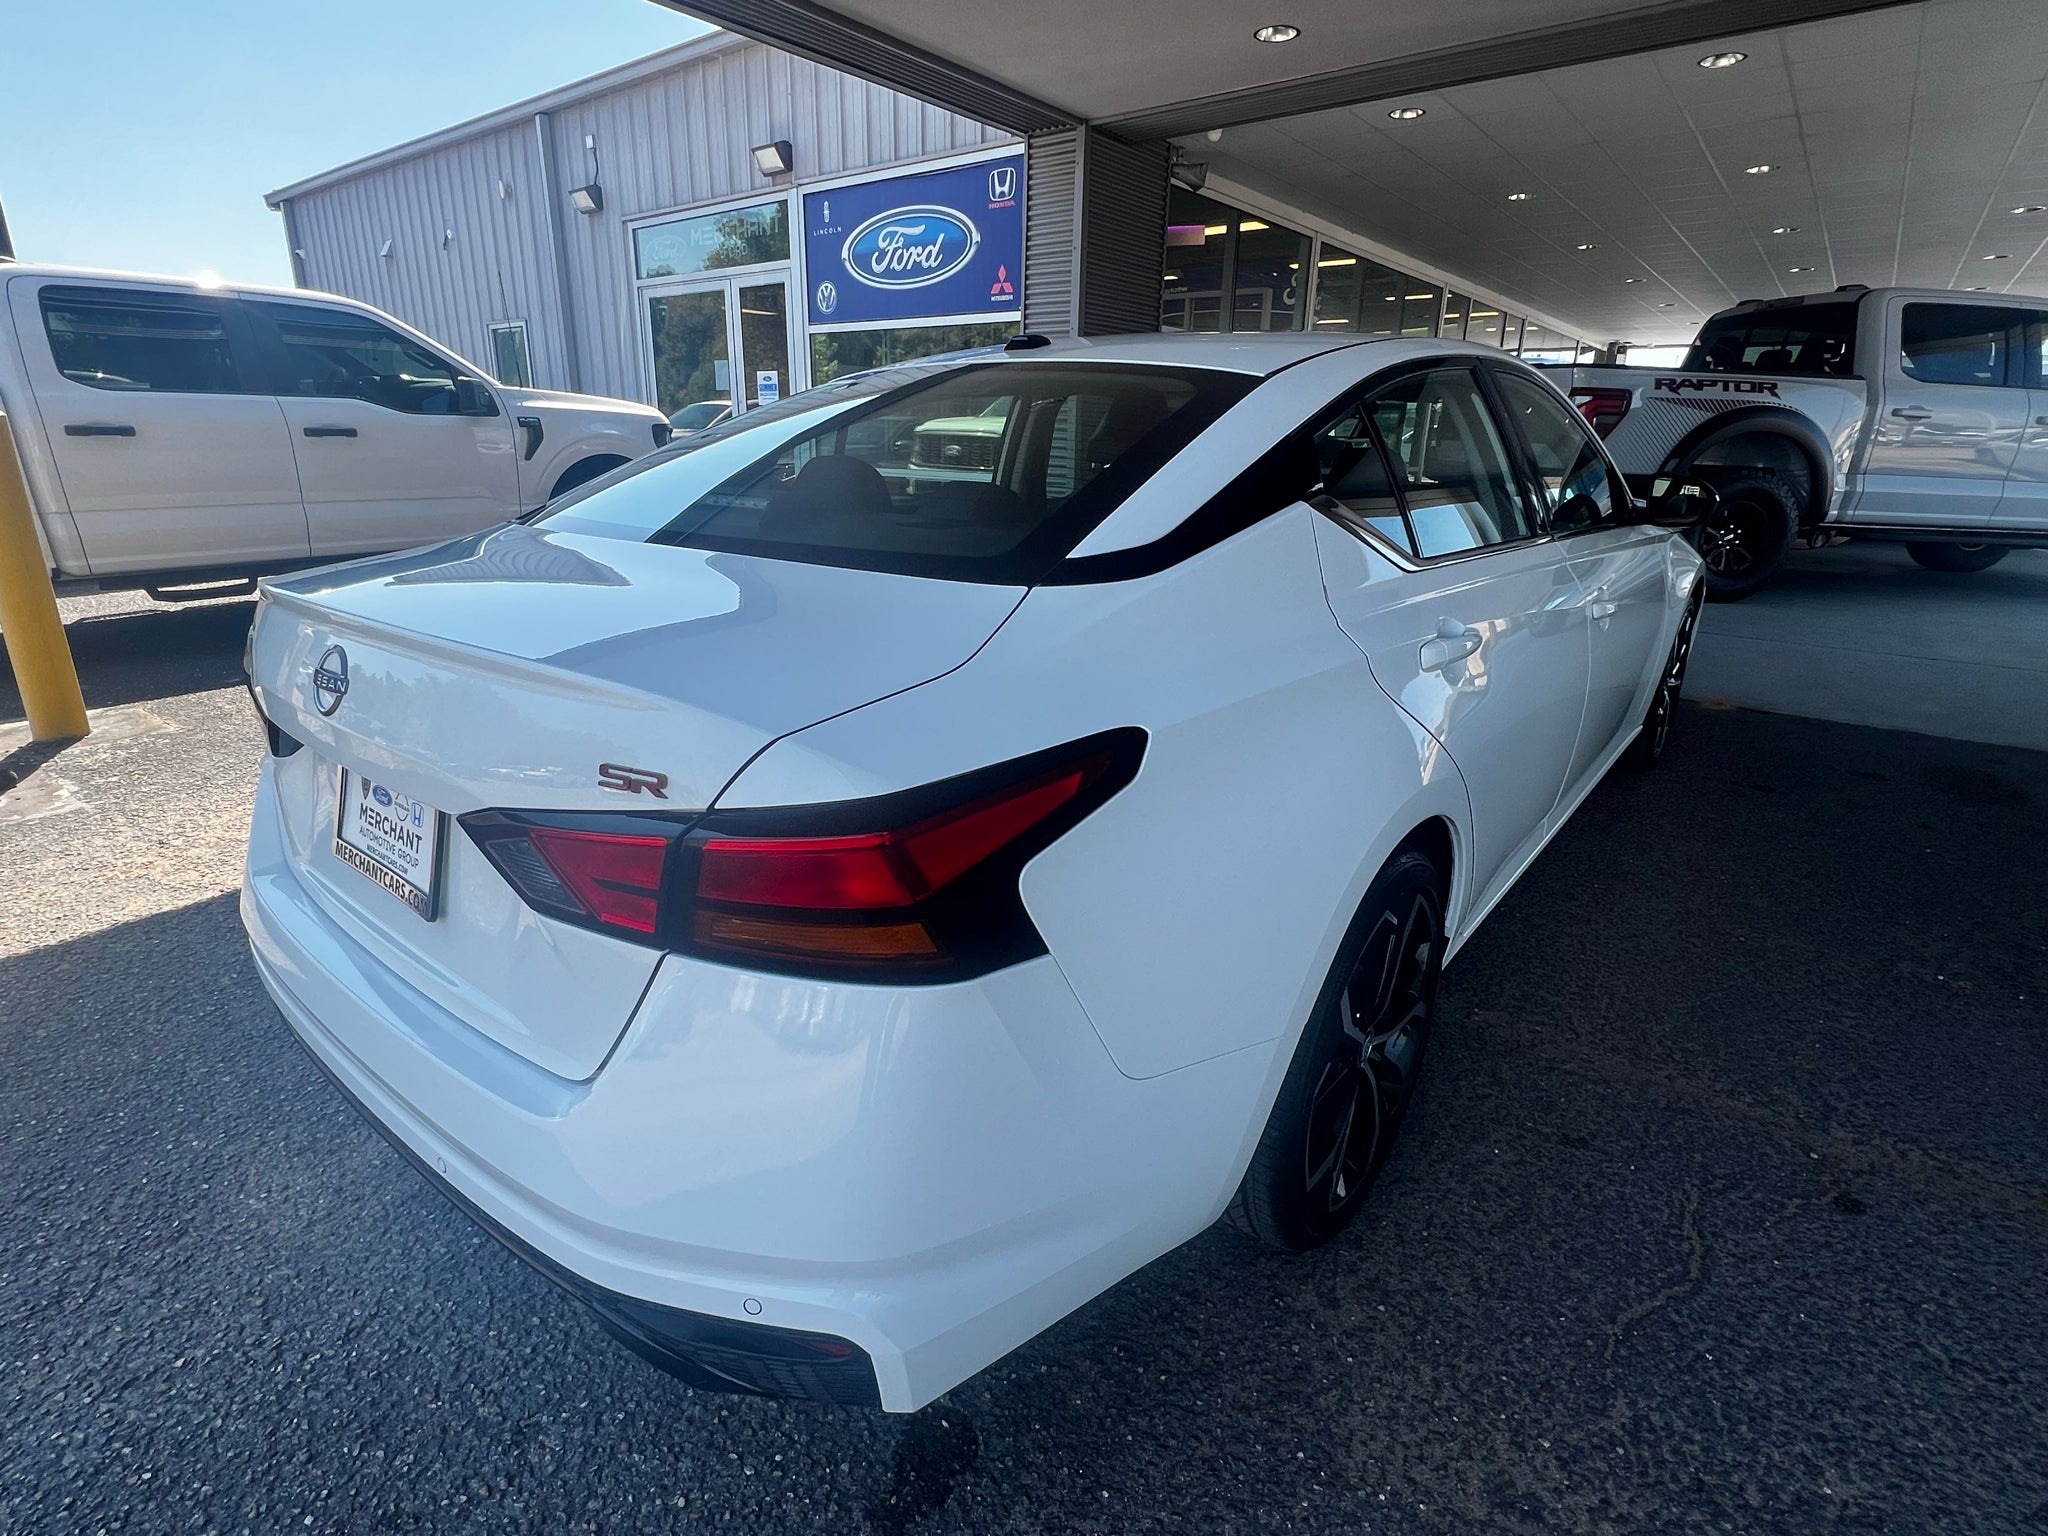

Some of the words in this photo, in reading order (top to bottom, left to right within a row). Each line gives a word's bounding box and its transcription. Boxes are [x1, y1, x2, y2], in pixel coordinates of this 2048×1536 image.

[988, 201, 1016, 210] HONDA
[813, 226, 843, 236] LINCOLN
[871, 223, 945, 274] Ford
[1654, 377, 1782, 400] RAPTOR
[597, 762, 669, 799] SR
[359, 802, 423, 854] MERCHANT
[359, 826, 397, 854] AUTOMOTIVE
[397, 847, 420, 869] GROUP
